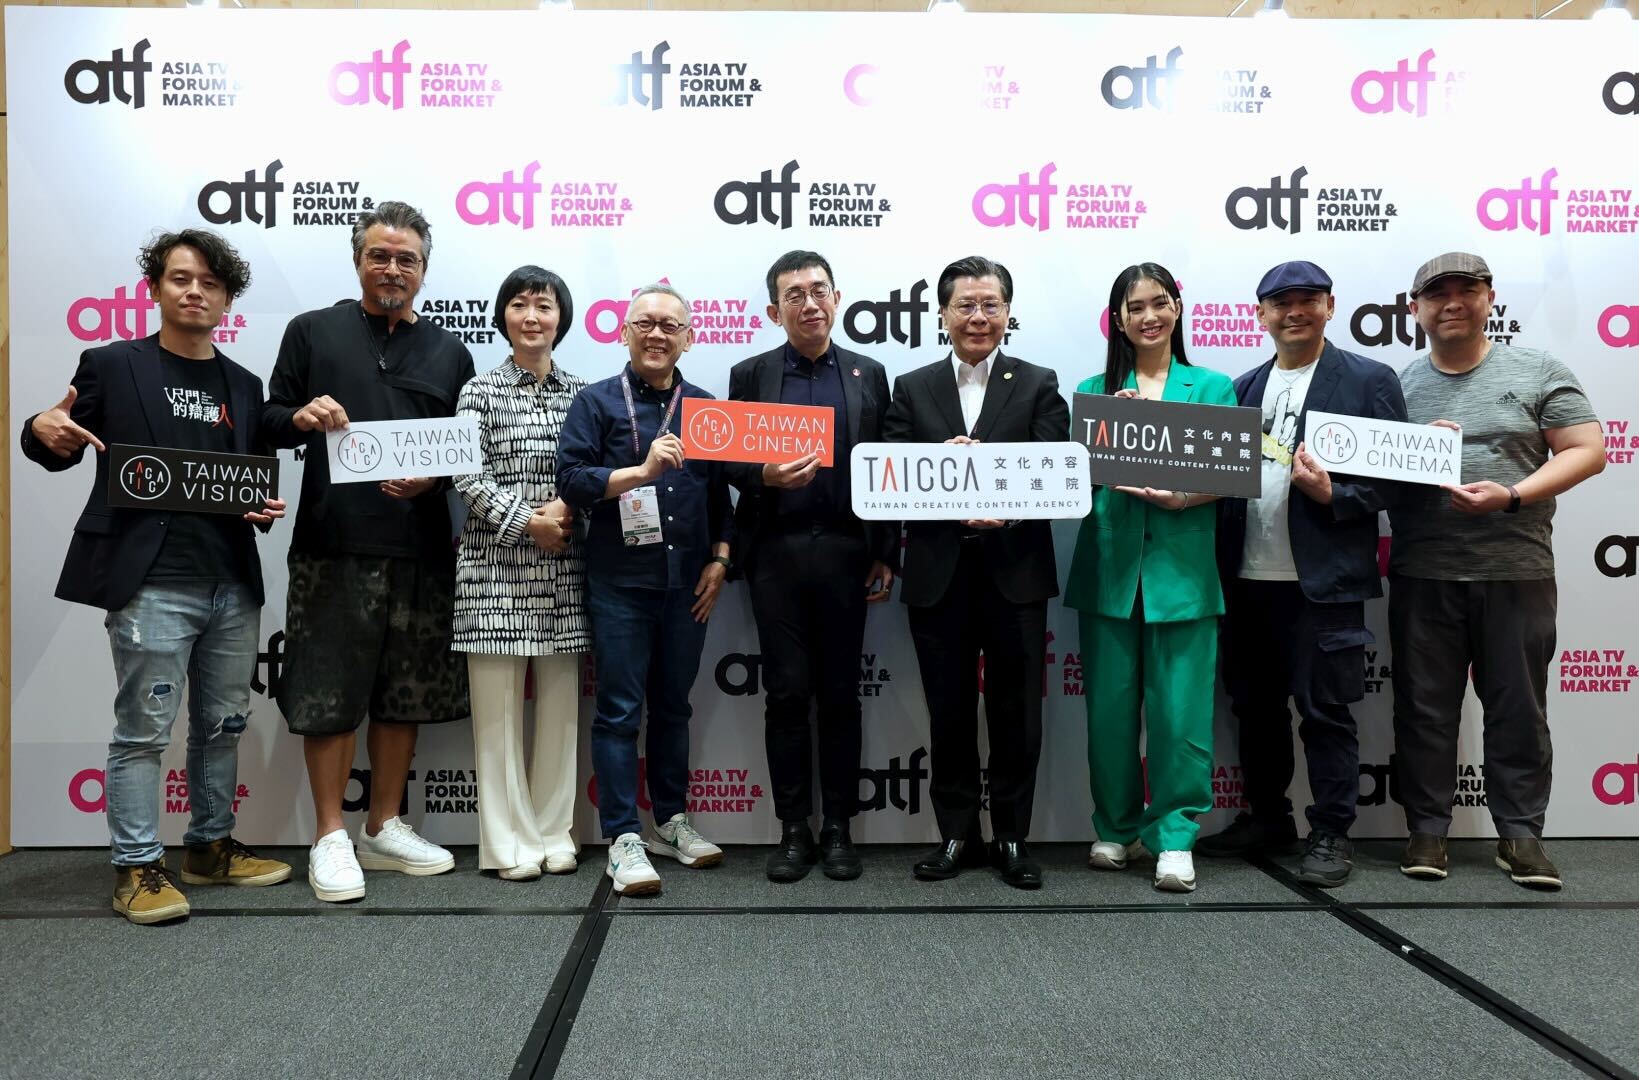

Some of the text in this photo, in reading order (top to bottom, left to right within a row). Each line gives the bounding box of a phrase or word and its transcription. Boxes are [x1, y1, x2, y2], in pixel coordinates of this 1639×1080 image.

[64, 38, 152, 109] atf
[162, 62, 228, 74] ASIA TV
[420, 63, 488, 75] ASIA TV
[680, 63, 748, 75] ASIA TV
[328, 39, 412, 110] atf
[1236, 70, 1258, 82] TV
[162, 78, 227, 90] FORUM
[421, 79, 503, 91] FORUM &
[680, 79, 762, 91] FORUM &
[1351, 48, 1436, 117] atf
[1260, 85, 1272, 98] &
[163, 94, 237, 106] MARKET
[421, 95, 496, 107] MARKET
[680, 95, 754, 107] MARKET
[198, 159, 284, 229] atf
[293, 182, 360, 194] ASIA TV
[551, 183, 617, 195] ASIA TV
[809, 183, 876, 196] ASIA TV
[1066, 185, 1132, 197] ASIA TV
[456, 160, 542, 229] atf
[714, 160, 800, 229] atf
[972, 162, 1057, 231] atf
[1225, 166, 1308, 234] atf
[1317, 189, 1382, 201] ASIA TV
[1567, 190, 1632, 202] ASIA TV
[293, 197, 375, 210] FORUM &
[551, 199, 632, 211] FORUM &
[810, 199, 891, 211] FORUM &
[1067, 200, 1147, 213] FORUM &
[1477, 168, 1558, 236] atf
[1317, 204, 1398, 216] FORUM &
[1567, 205, 1629, 218] FORUM
[551, 214, 624, 226] MARKET
[810, 214, 883, 226] MARKET
[1067, 216, 1139, 228] MARKET
[1317, 219, 1390, 231] MARKET
[1567, 221, 1638, 233] MARKET
[67, 276, 155, 341] atf
[421, 301, 488, 313] ASIA TV
[690, 300, 747, 312] SIA TV
[1192, 304, 1257, 316] ASIA TV
[843, 279, 929, 349] atf
[234, 315, 247, 327] &
[691, 316, 762, 328] ORUM &
[1008, 317, 1020, 330] &
[1192, 319, 1254, 331] FORUM
[1510, 320, 1521, 332] &
[692, 331, 754, 343] ARKET
[1192, 334, 1263, 347] MARKET
[744, 413, 826, 433] TAIWAN
[1606, 421, 1628, 433] TV
[390, 428, 471, 447] TAIWAN
[1082, 418, 1173, 453] TAICCA
[1369, 429, 1453, 454] TAIWAN
[743, 435, 827, 455] CINEMA
[393, 448, 473, 467] VISION
[1119, 455, 1164, 465] CREATIVE
[1168, 460, 1210, 469] CONTENT
[1214, 464, 1251, 472] AGENCY
[1367, 450, 1453, 475] CINEMA
[1605, 451, 1634, 464] KET
[183, 462, 270, 484] TAIWAN
[862, 456, 980, 493] TAICCA
[183, 482, 270, 504] VISION
[976, 501, 1029, 509] CONTENT
[1560, 650, 1624, 662] ASIA TV
[877, 669, 890, 681] &
[1560, 665, 1639, 677] FORUM &
[1560, 680, 1631, 692] MARKET
[424, 770, 466, 782] ASIA
[726, 770, 748, 782] TV
[236, 784, 249, 797] &
[425, 785, 477, 797] FORU
[686, 785, 763, 797] ORUM &
[425, 800, 478, 813] MARK
